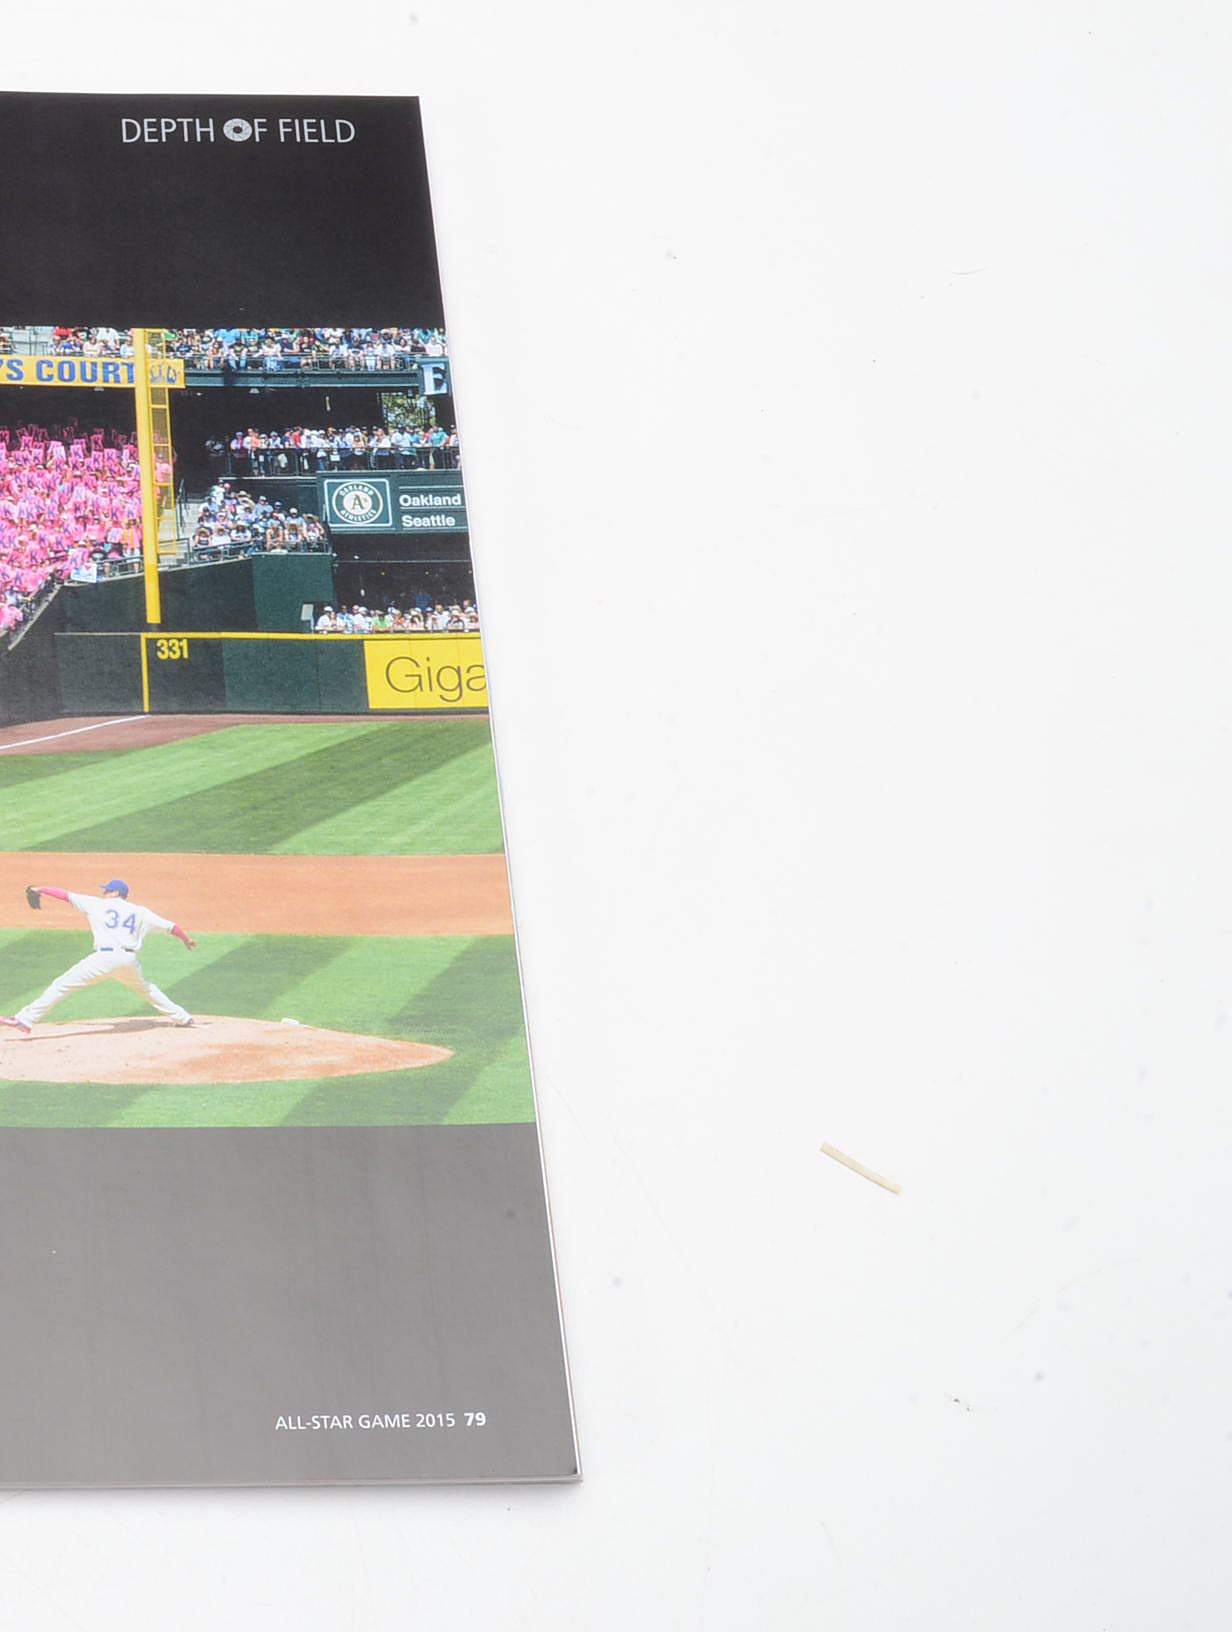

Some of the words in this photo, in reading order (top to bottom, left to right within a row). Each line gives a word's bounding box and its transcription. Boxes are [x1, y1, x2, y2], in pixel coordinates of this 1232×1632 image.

[121, 118, 215, 142] DEPTH
[222, 118, 268, 142] OF
[278, 118, 356, 142] FIELD
[36, 359, 135, 384] COURT
[399, 494, 461, 507] Oakland
[402, 515, 455, 527] Seattle
[157, 639, 189, 659] 331
[385, 656, 486, 702] Giga
[104, 909, 136, 935] 34
[275, 1414, 354, 1430] ALL-STAR
[358, 1413, 411, 1428] GAME
[416, 1412, 455, 1427] 2015
[463, 1411, 487, 1427] 79
